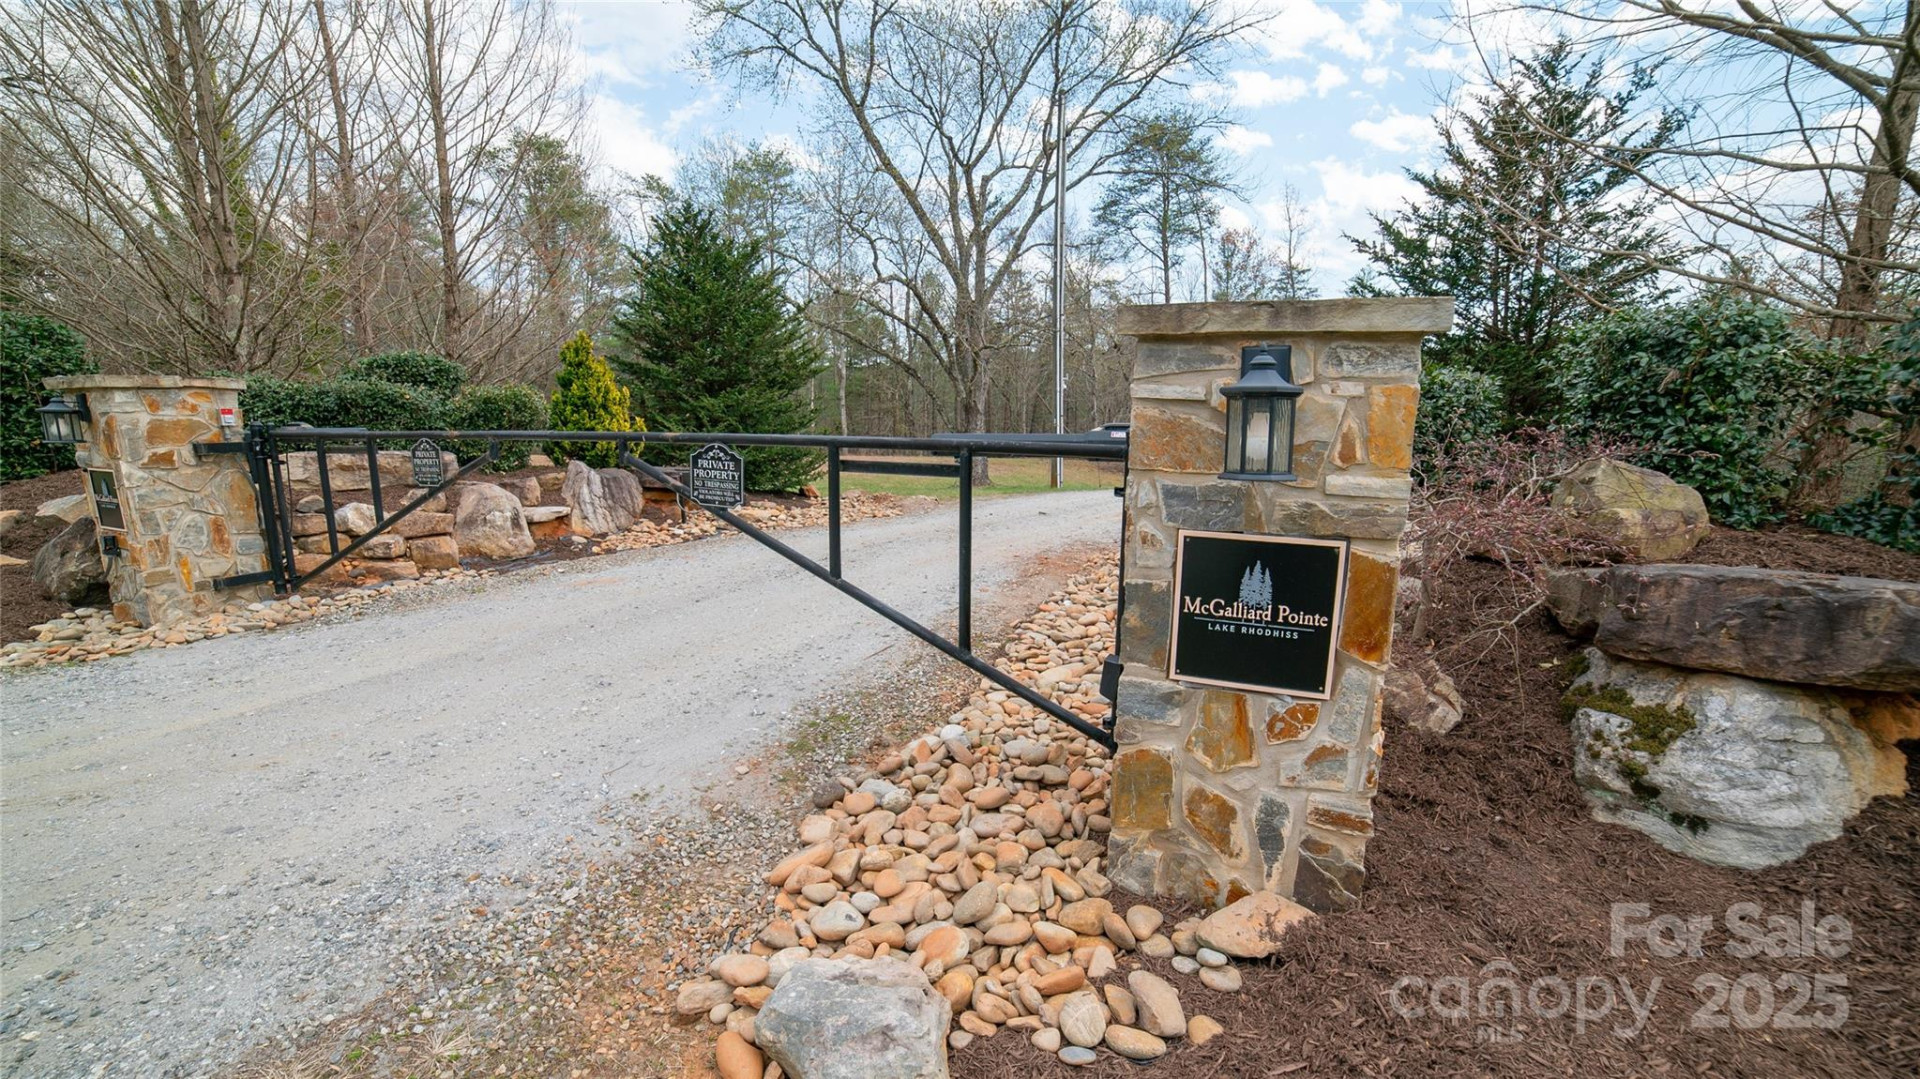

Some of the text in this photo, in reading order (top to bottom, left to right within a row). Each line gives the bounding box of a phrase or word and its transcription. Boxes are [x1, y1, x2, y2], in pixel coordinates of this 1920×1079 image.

[698, 459, 735, 470] PRIVATE
[693, 469, 739, 480] PROPERTY
[704, 481, 739, 489] TRESPASSING
[1182, 595, 1328, 627] McGalliard Pointe
[1207, 622, 1299, 640] LAKE RHODHISS
